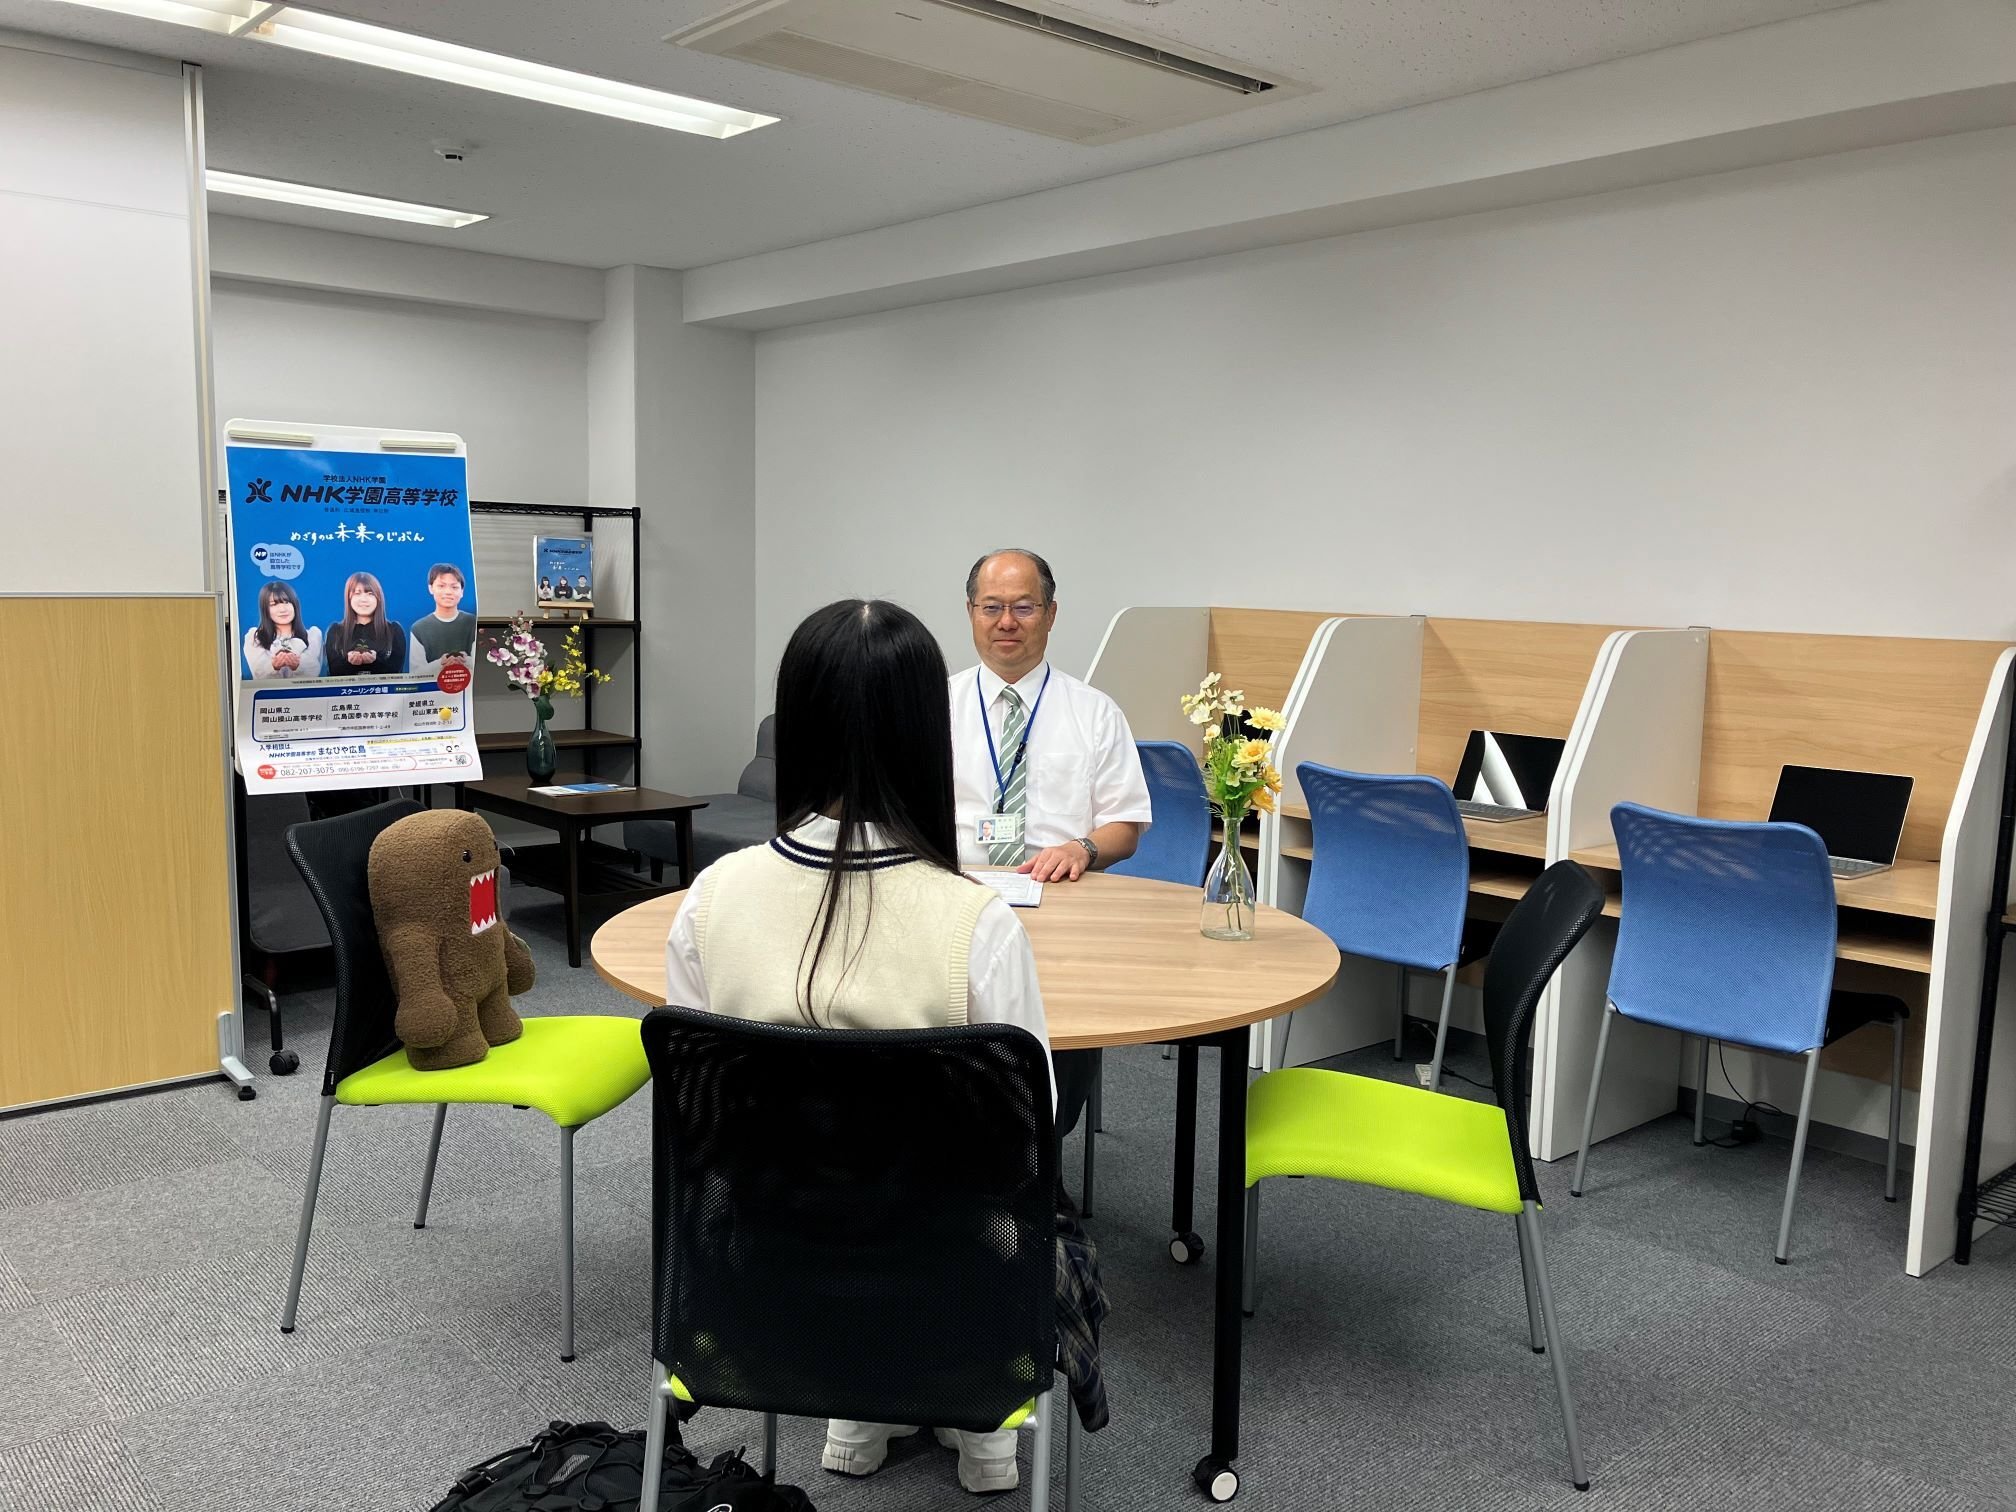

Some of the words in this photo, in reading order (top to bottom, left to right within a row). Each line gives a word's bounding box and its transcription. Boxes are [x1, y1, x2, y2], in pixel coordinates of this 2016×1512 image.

[280, 484, 459, 507] NHK学園高等学校
[340, 686, 389, 695] スクーリング会場
[412, 707, 459, 716] 松山東高校
[280, 766, 335, 777] 082-207-3075
